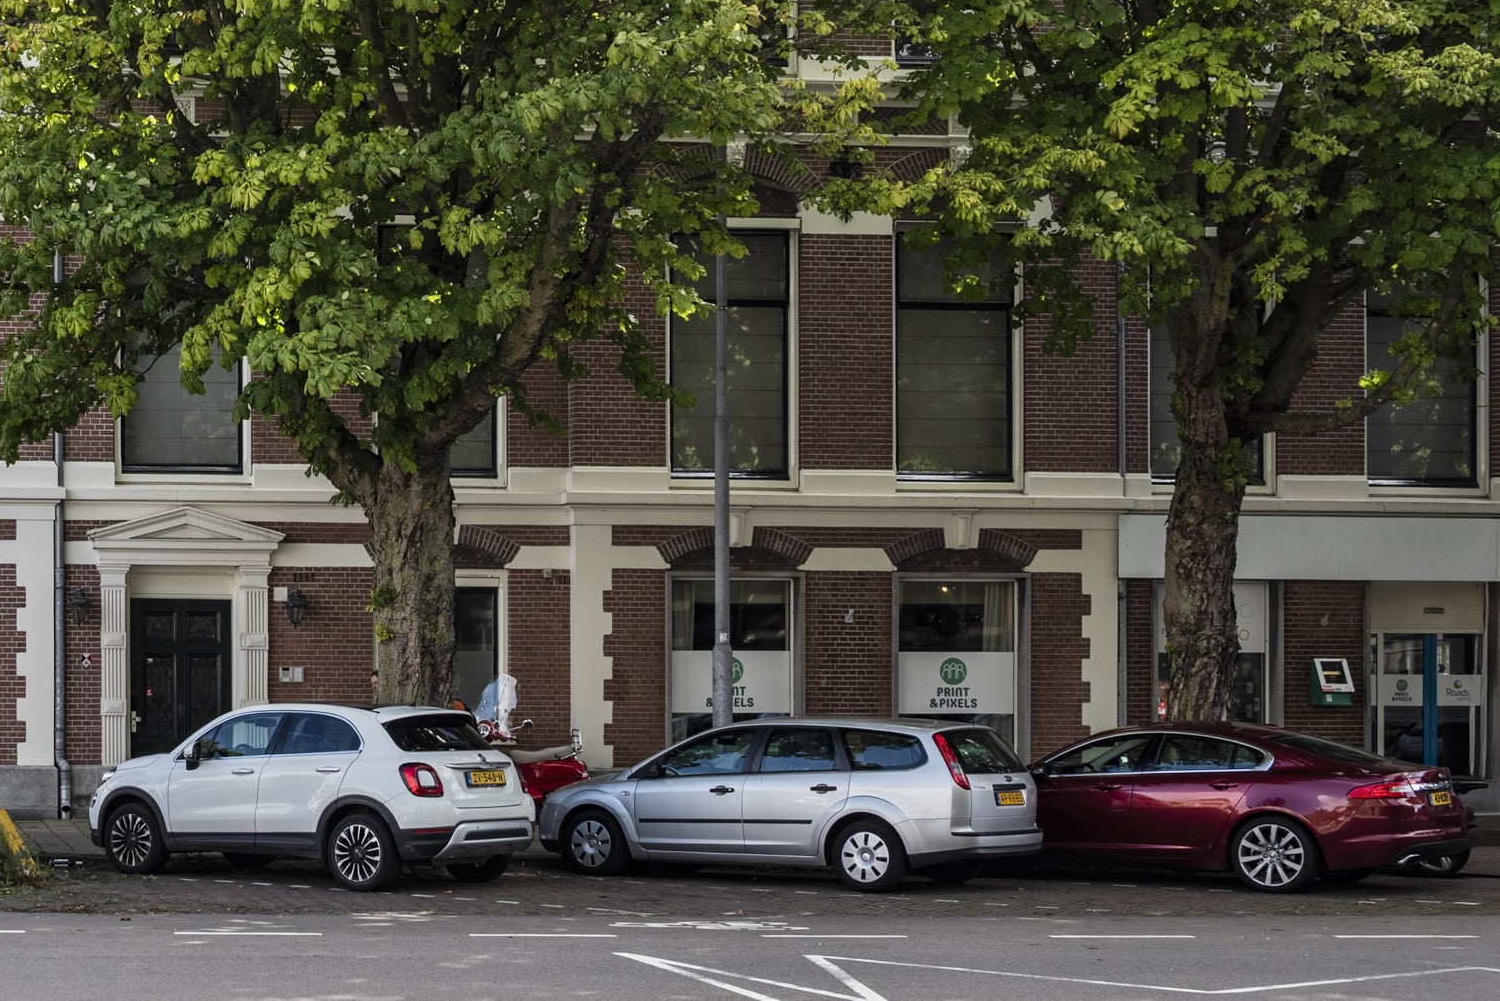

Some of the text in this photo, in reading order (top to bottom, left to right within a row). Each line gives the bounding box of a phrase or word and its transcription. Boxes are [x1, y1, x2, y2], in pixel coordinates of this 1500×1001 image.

[937, 687, 970, 697] PRINT
[1445, 688, 1470, 697] Roads
[473, 773, 504, 783] ZV-548-N
